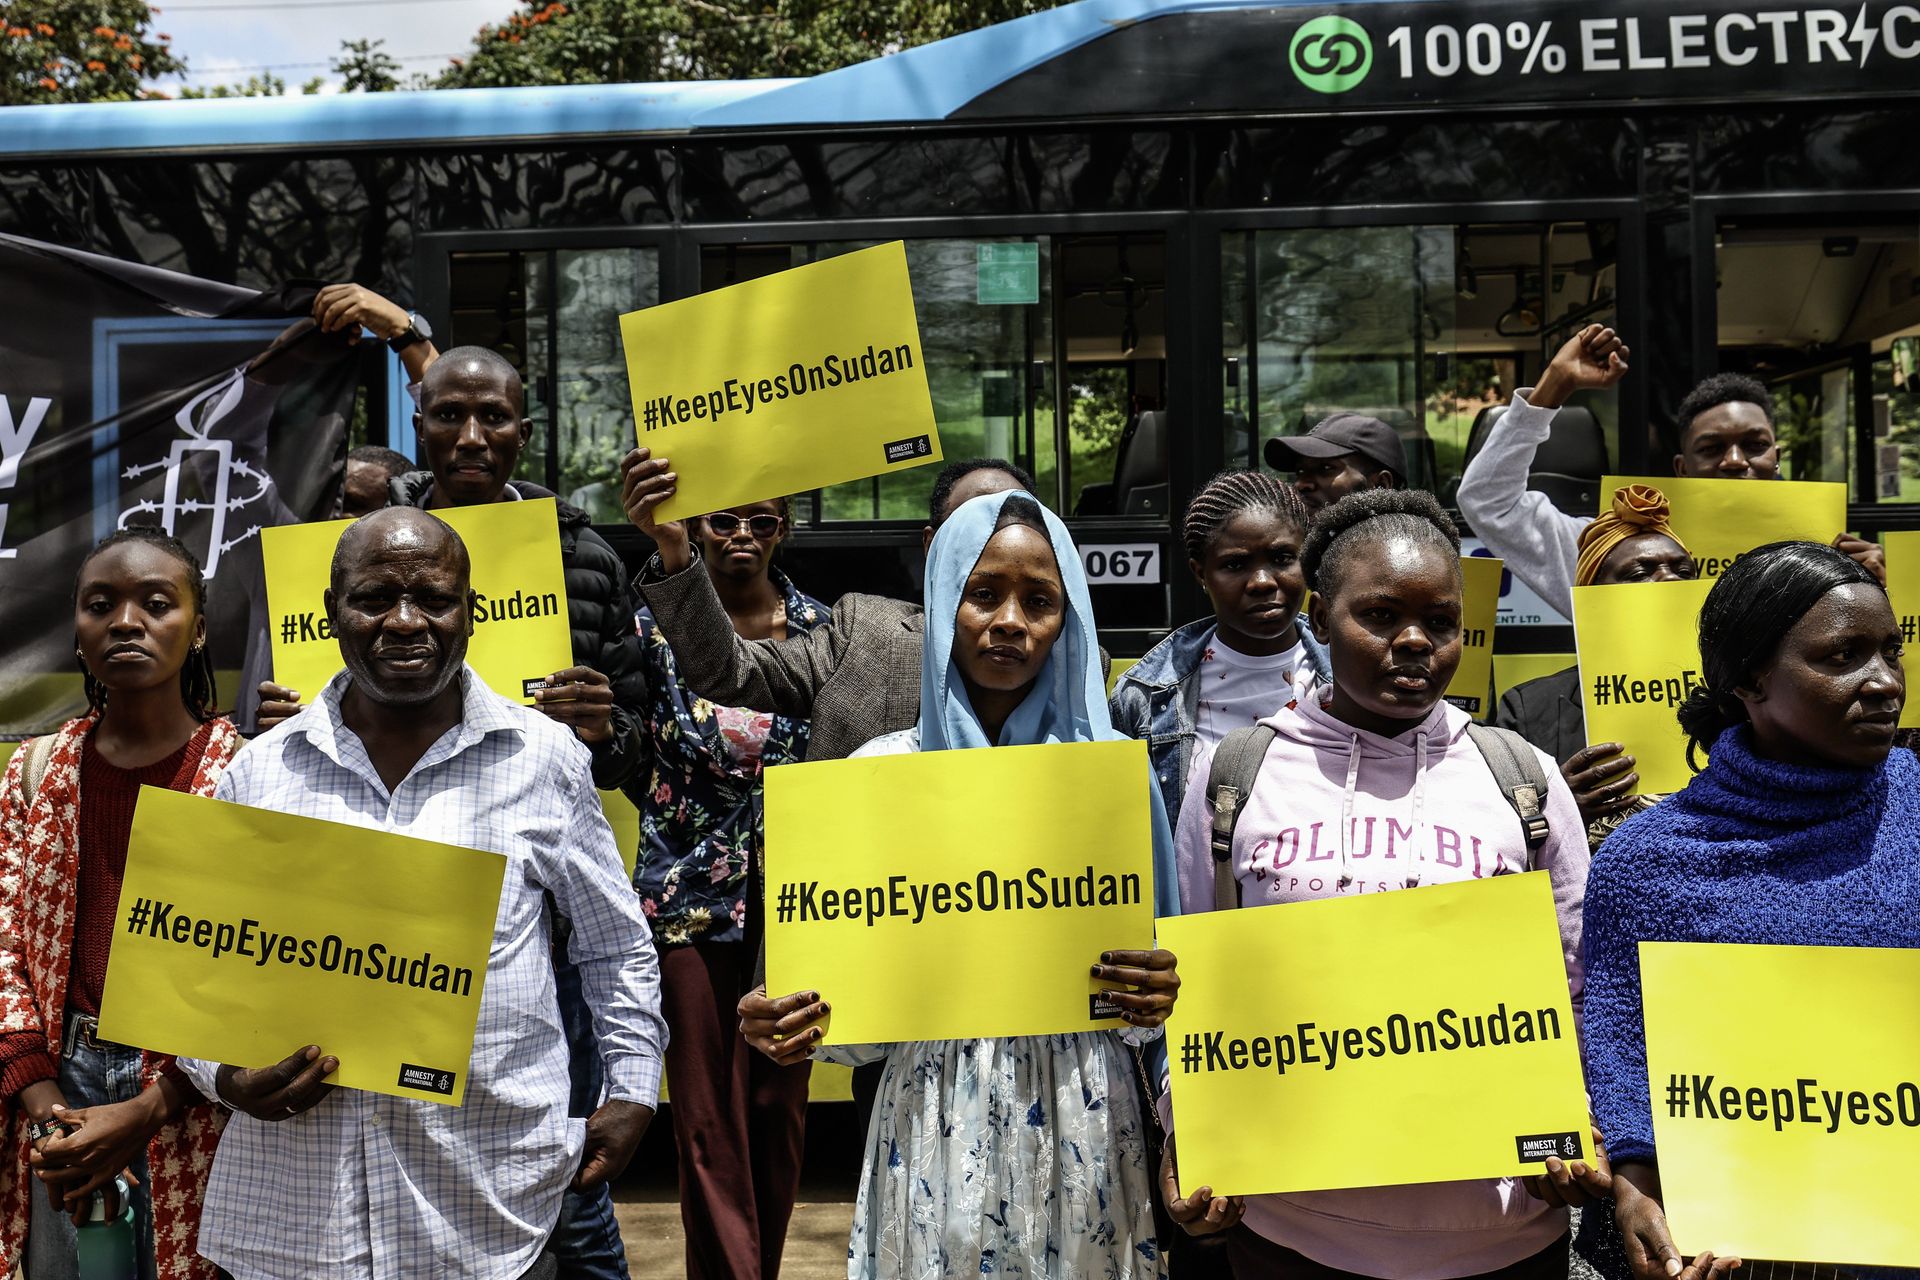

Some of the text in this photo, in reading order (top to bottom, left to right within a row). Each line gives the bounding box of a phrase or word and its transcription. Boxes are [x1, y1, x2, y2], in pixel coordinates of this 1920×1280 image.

[1388, 20, 1566, 78] 100%
[643, 344, 913, 432] #KeepEyesOnSudan
[1085, 550, 1154, 578] 067
[1520, 615, 1541, 623] LTD
[776, 865, 1141, 927] #KeepEyesOnSudan
[127, 897, 473, 997] #KeepEyesOnSudan
[1181, 1003, 1561, 1075] #KeepEyesOnSudan
[404, 1069, 435, 1081] AMNESTY
[1523, 1139, 1557, 1150] AMNESTY
